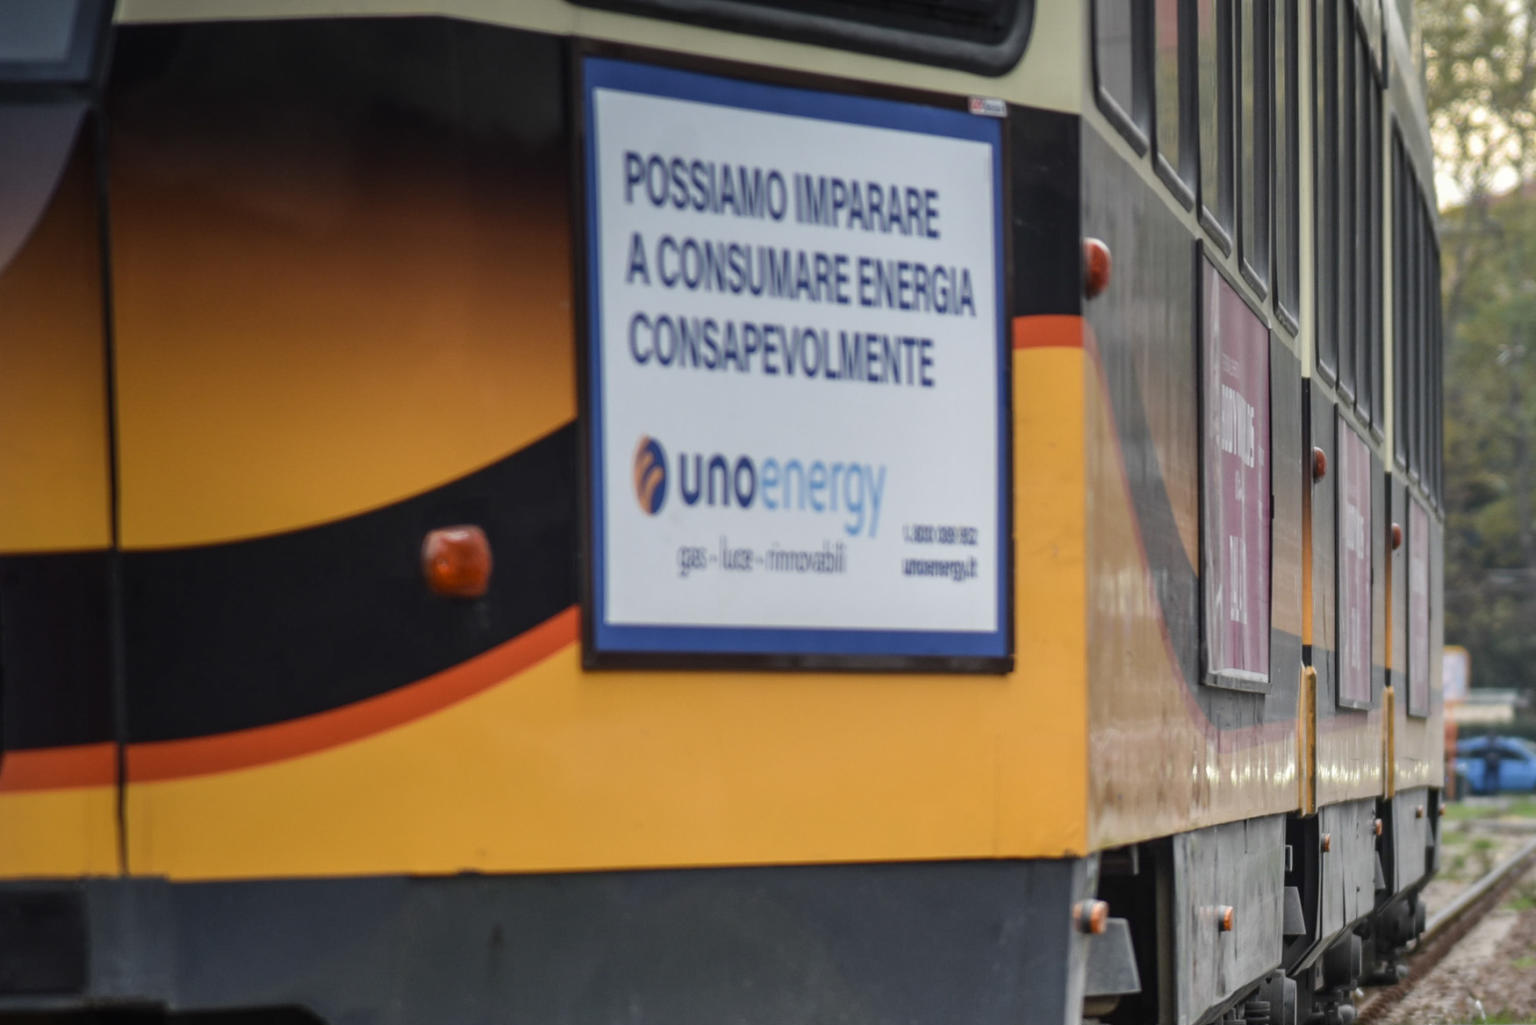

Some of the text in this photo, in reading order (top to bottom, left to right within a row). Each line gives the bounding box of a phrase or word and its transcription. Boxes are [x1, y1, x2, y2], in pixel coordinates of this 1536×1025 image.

[624, 150, 942, 240] POSSIAMO IMPARARE
[624, 231, 977, 317] A CONSUMARE ENERGIA
[628, 311, 936, 388] CONSAPEVOLMENTE
[676, 451, 888, 539] unoenergy
[677, 536, 848, 579] gas luce rinnovabili
